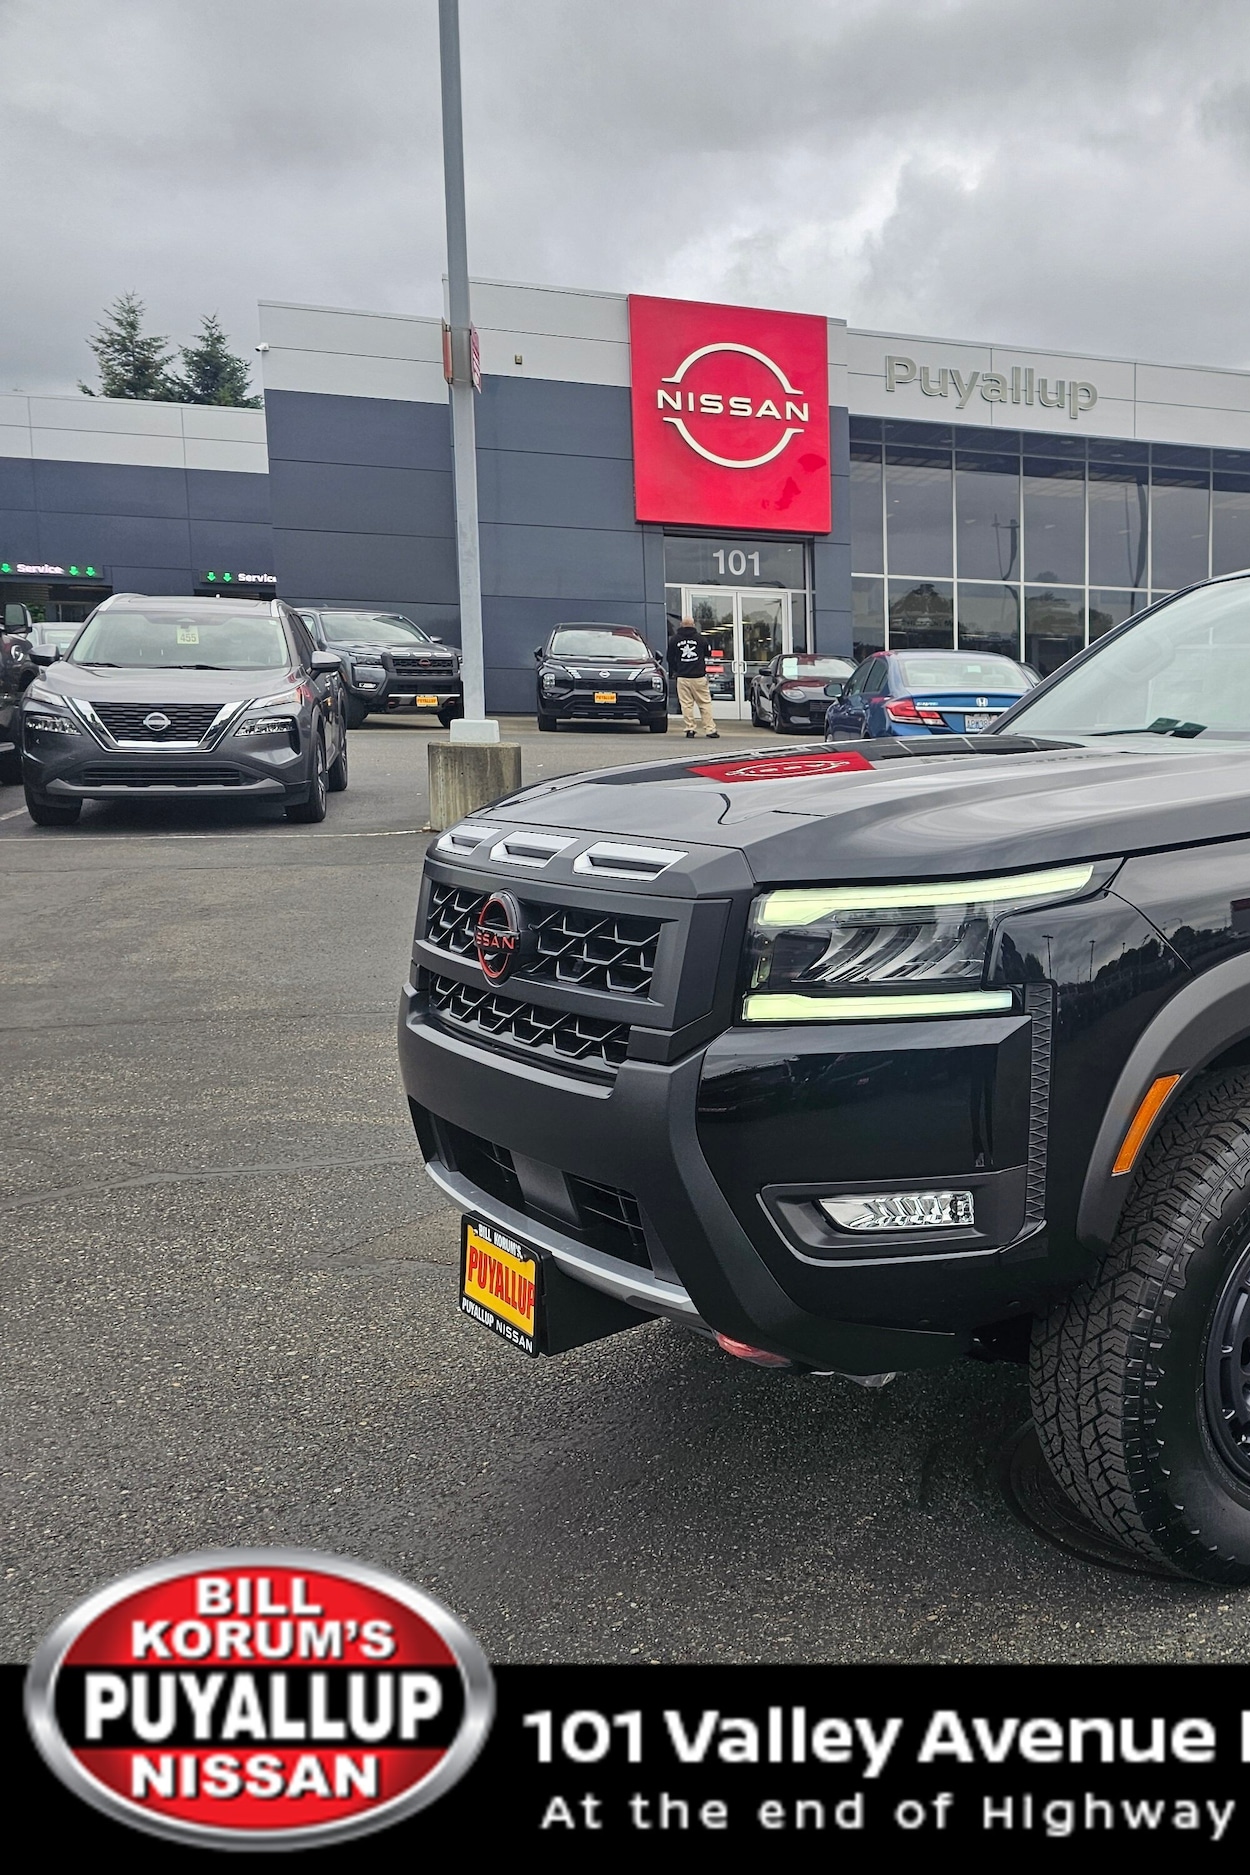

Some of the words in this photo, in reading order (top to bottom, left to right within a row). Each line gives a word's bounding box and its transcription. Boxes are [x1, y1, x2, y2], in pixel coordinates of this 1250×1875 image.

[885, 355, 1099, 420] Puyallup
[657, 388, 809, 422] NISSAN
[16, 563, 64, 575] Service
[712, 548, 761, 577] 101
[179, 633, 197, 643] 455
[478, 1223, 493, 1242] BILL
[467, 1245, 535, 1321] PUYALLUP
[461, 1297, 495, 1328] PUYALLUP
[495, 1319, 534, 1354] NISSAN
